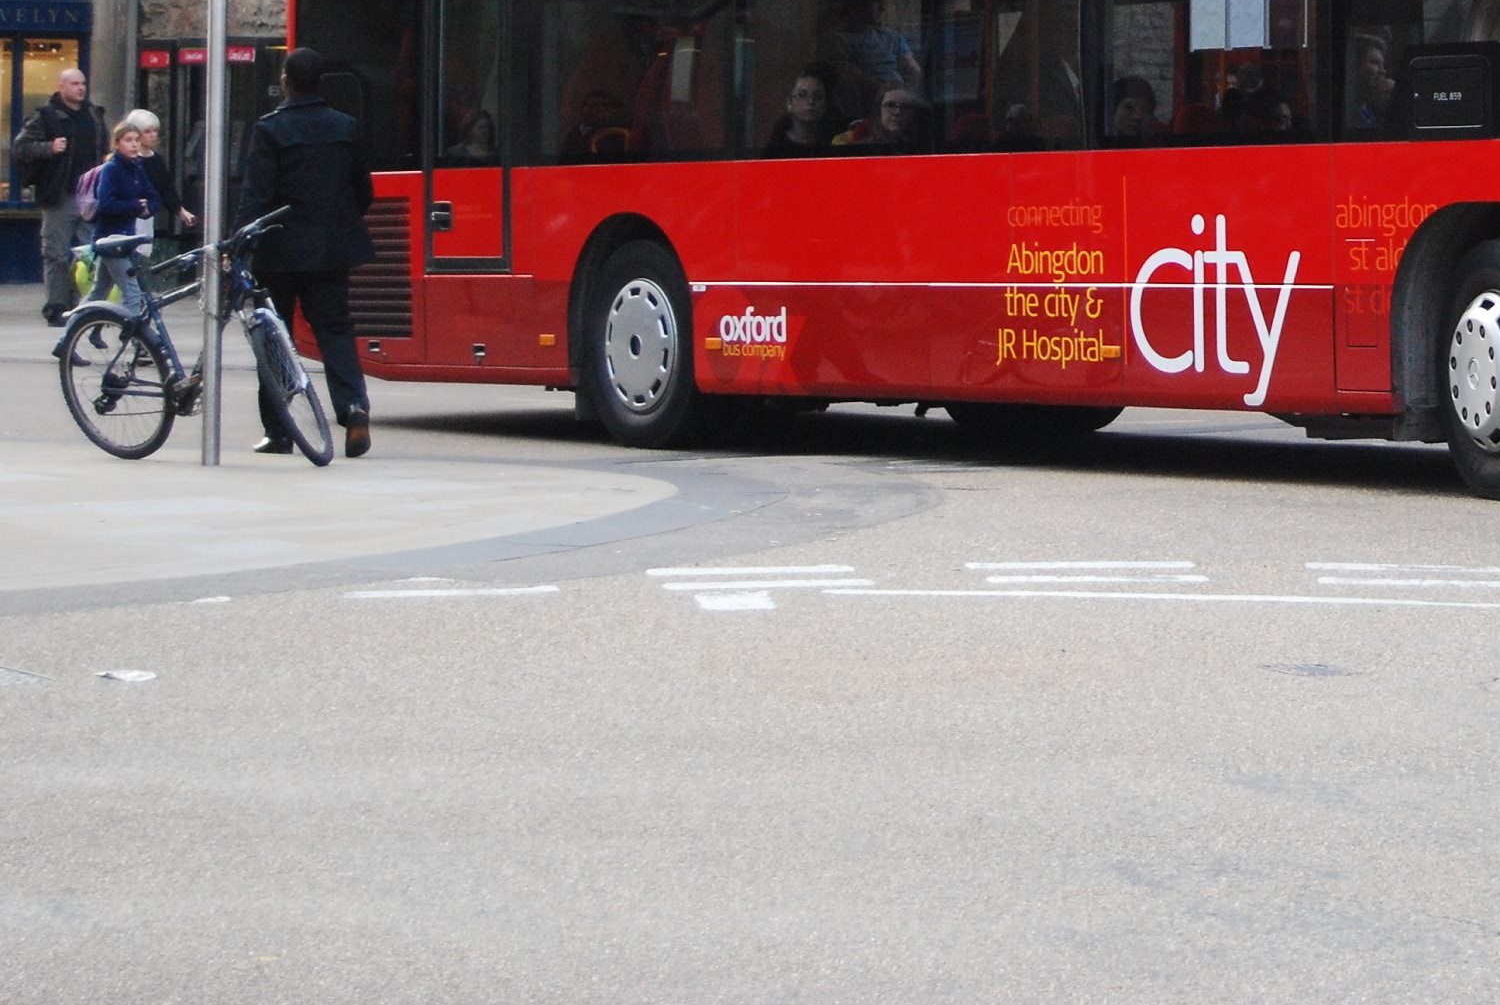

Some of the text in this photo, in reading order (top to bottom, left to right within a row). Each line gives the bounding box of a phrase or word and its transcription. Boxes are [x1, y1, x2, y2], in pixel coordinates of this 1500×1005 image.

[1007, 198, 1104, 234] connecting
[1007, 242, 1104, 283] Abingdon
[1349, 240, 1369, 271] st
[720, 305, 787, 345] oxford
[1004, 287, 1104, 326] the city &
[1130, 213, 1301, 407] city
[722, 341, 787, 362] bus company
[996, 329, 1104, 370] JR Hospital
